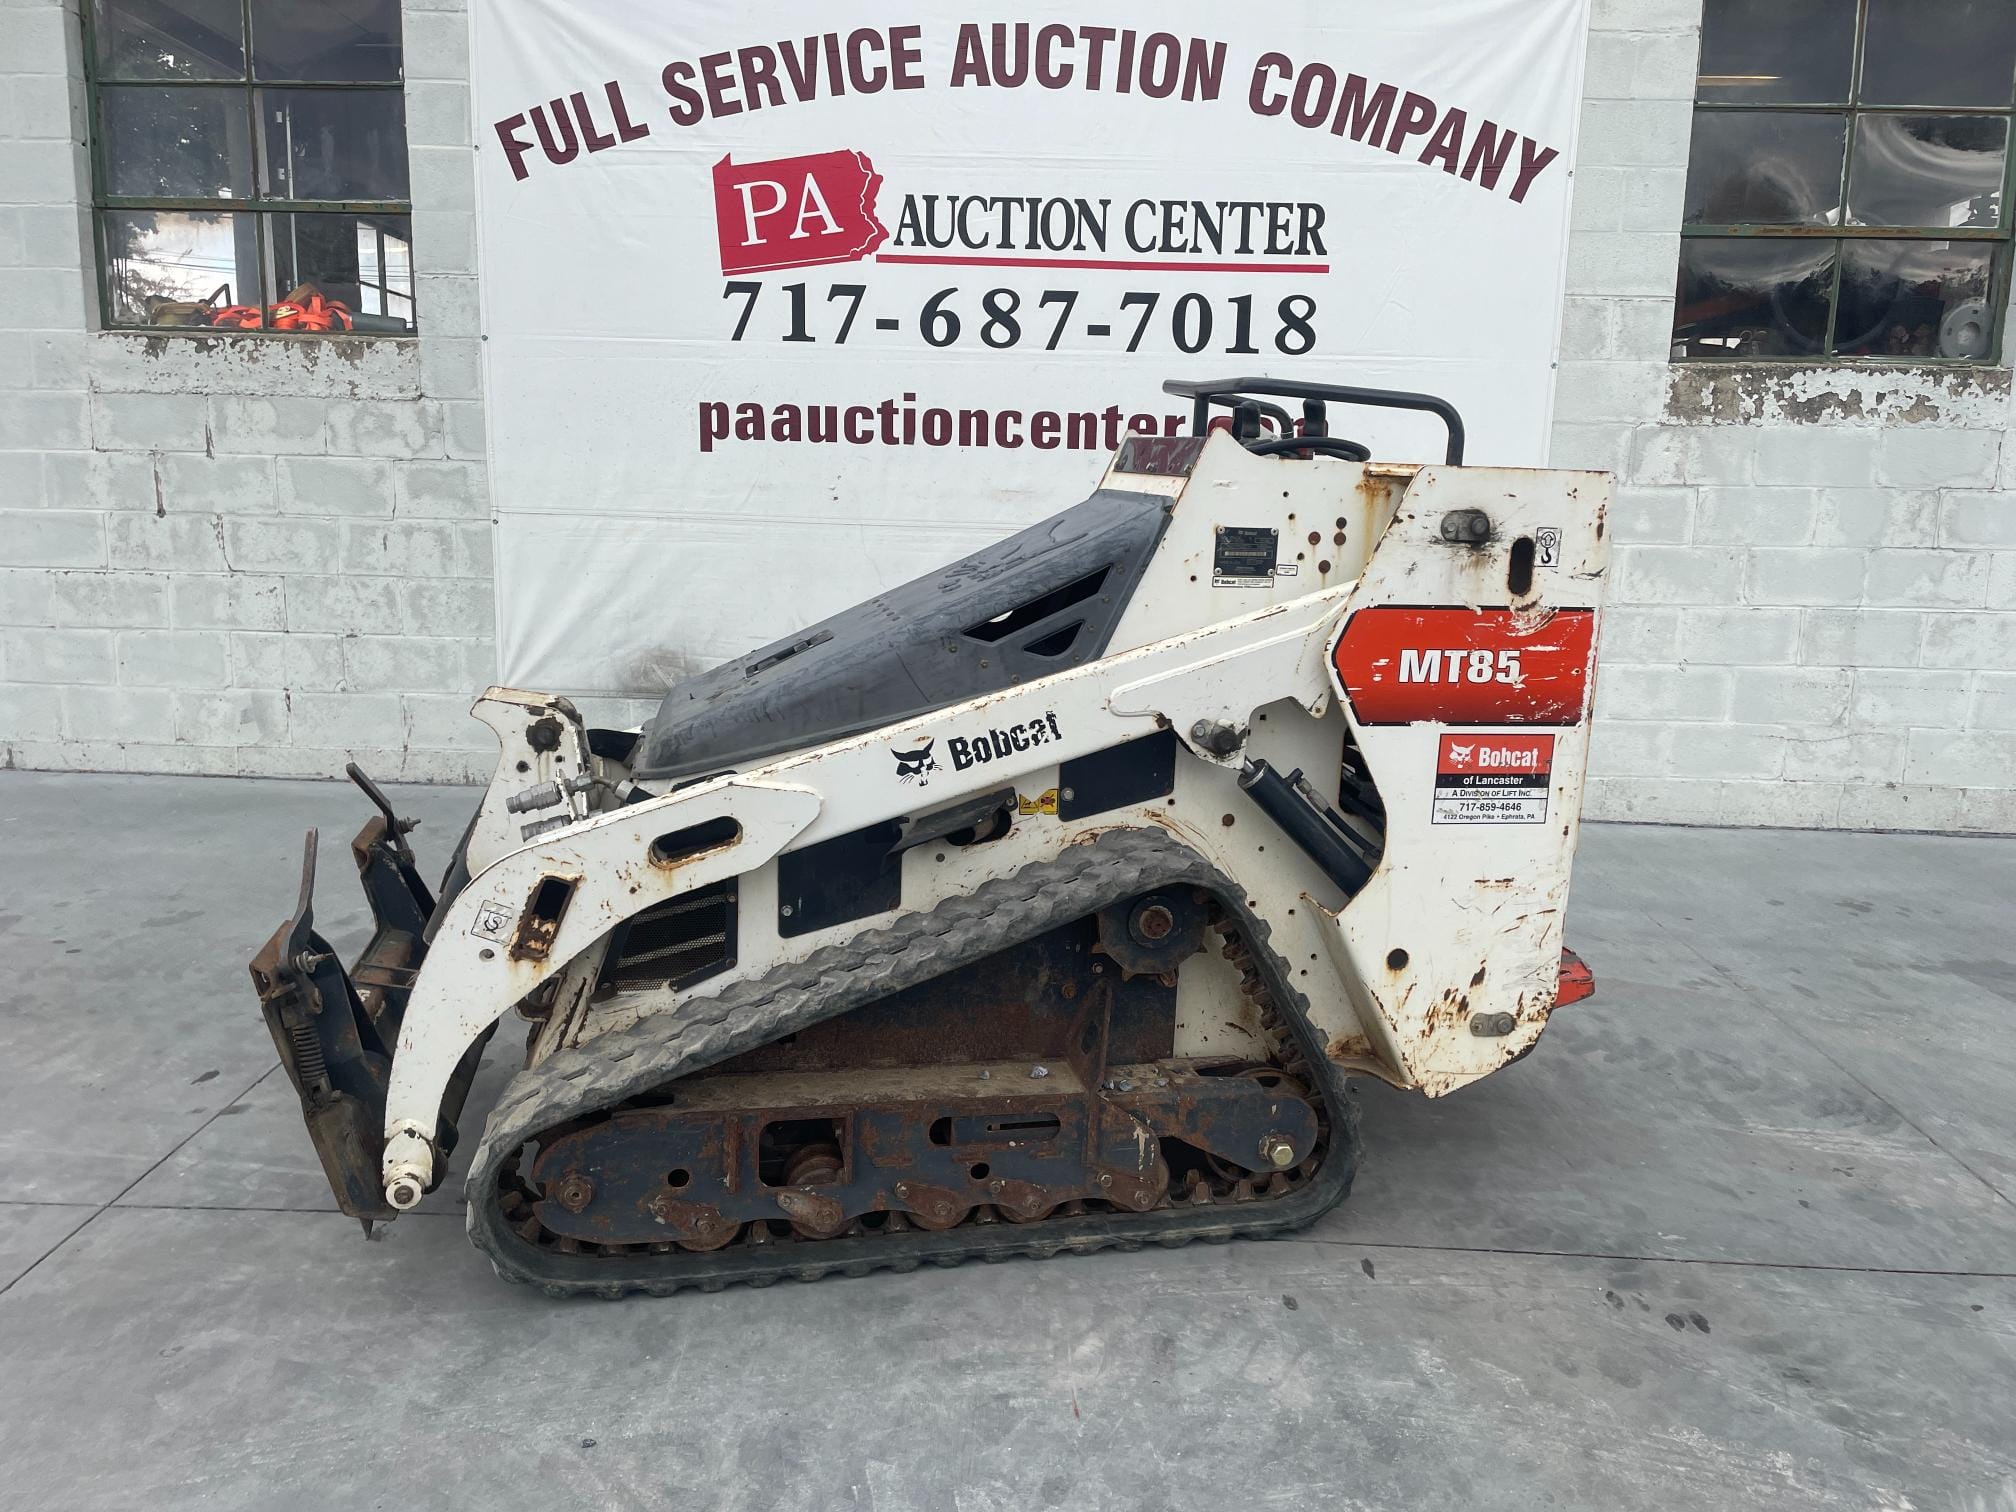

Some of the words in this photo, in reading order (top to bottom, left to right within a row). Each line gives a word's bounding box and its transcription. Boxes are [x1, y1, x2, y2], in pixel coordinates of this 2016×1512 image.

[494, 80, 650, 182] FULL
[661, 25, 925, 128] SERVICE
[950, 22, 1228, 102] AUCTION
[1248, 51, 1559, 204] COMPANY
[732, 172, 844, 247] PA
[893, 193, 1111, 252] AUCTION
[1124, 199, 1328, 256] CENTER
[722, 280, 1318, 355] 717-687-7018
[1398, 648, 1521, 684] MT85
[947, 711, 1063, 772] Bobcat
[1478, 747, 1538, 768] Bobcat
[1452, 789, 1458, 797] A
[1463, 775, 1474, 785] of
[1476, 775, 1523, 785] Lancaster
[1459, 813, 1481, 821] Oregon
[1460, 802, 1522, 812] 717-859-4646
